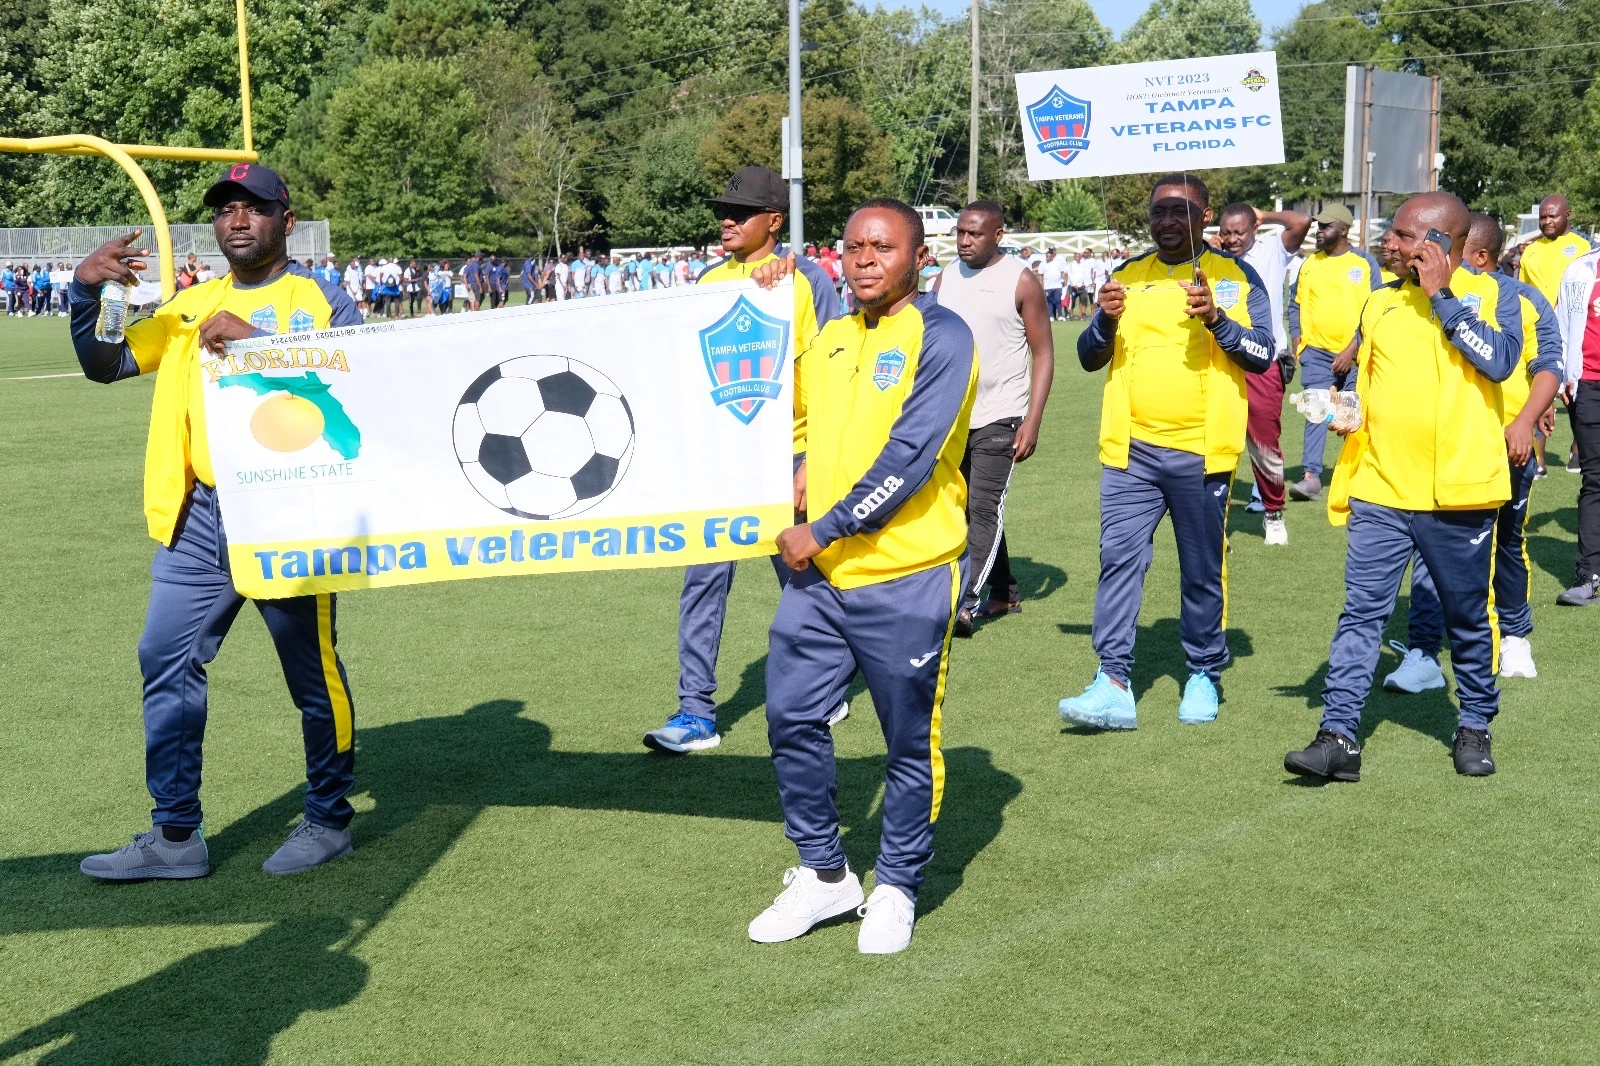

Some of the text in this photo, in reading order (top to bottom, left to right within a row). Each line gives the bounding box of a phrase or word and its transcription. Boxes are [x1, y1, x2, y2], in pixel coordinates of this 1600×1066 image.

[1144, 72, 1210, 88] NVT 2023
[1126, 93, 1150, 101] HOST:
[1144, 96, 1236, 114] TAMPA
[1034, 112, 1085, 123] TAMPA VETERANS
[1110, 114, 1272, 137] VETERANS FC
[1152, 138, 1236, 152] FLORIDA
[710, 339, 777, 356] TAMPA VETERANS
[201, 347, 351, 383] FLORIDA
[718, 383, 771, 399] FOOTBALL CLUB
[236, 462, 353, 485] SUNSHINE STATE
[703, 515, 761, 549] FC
